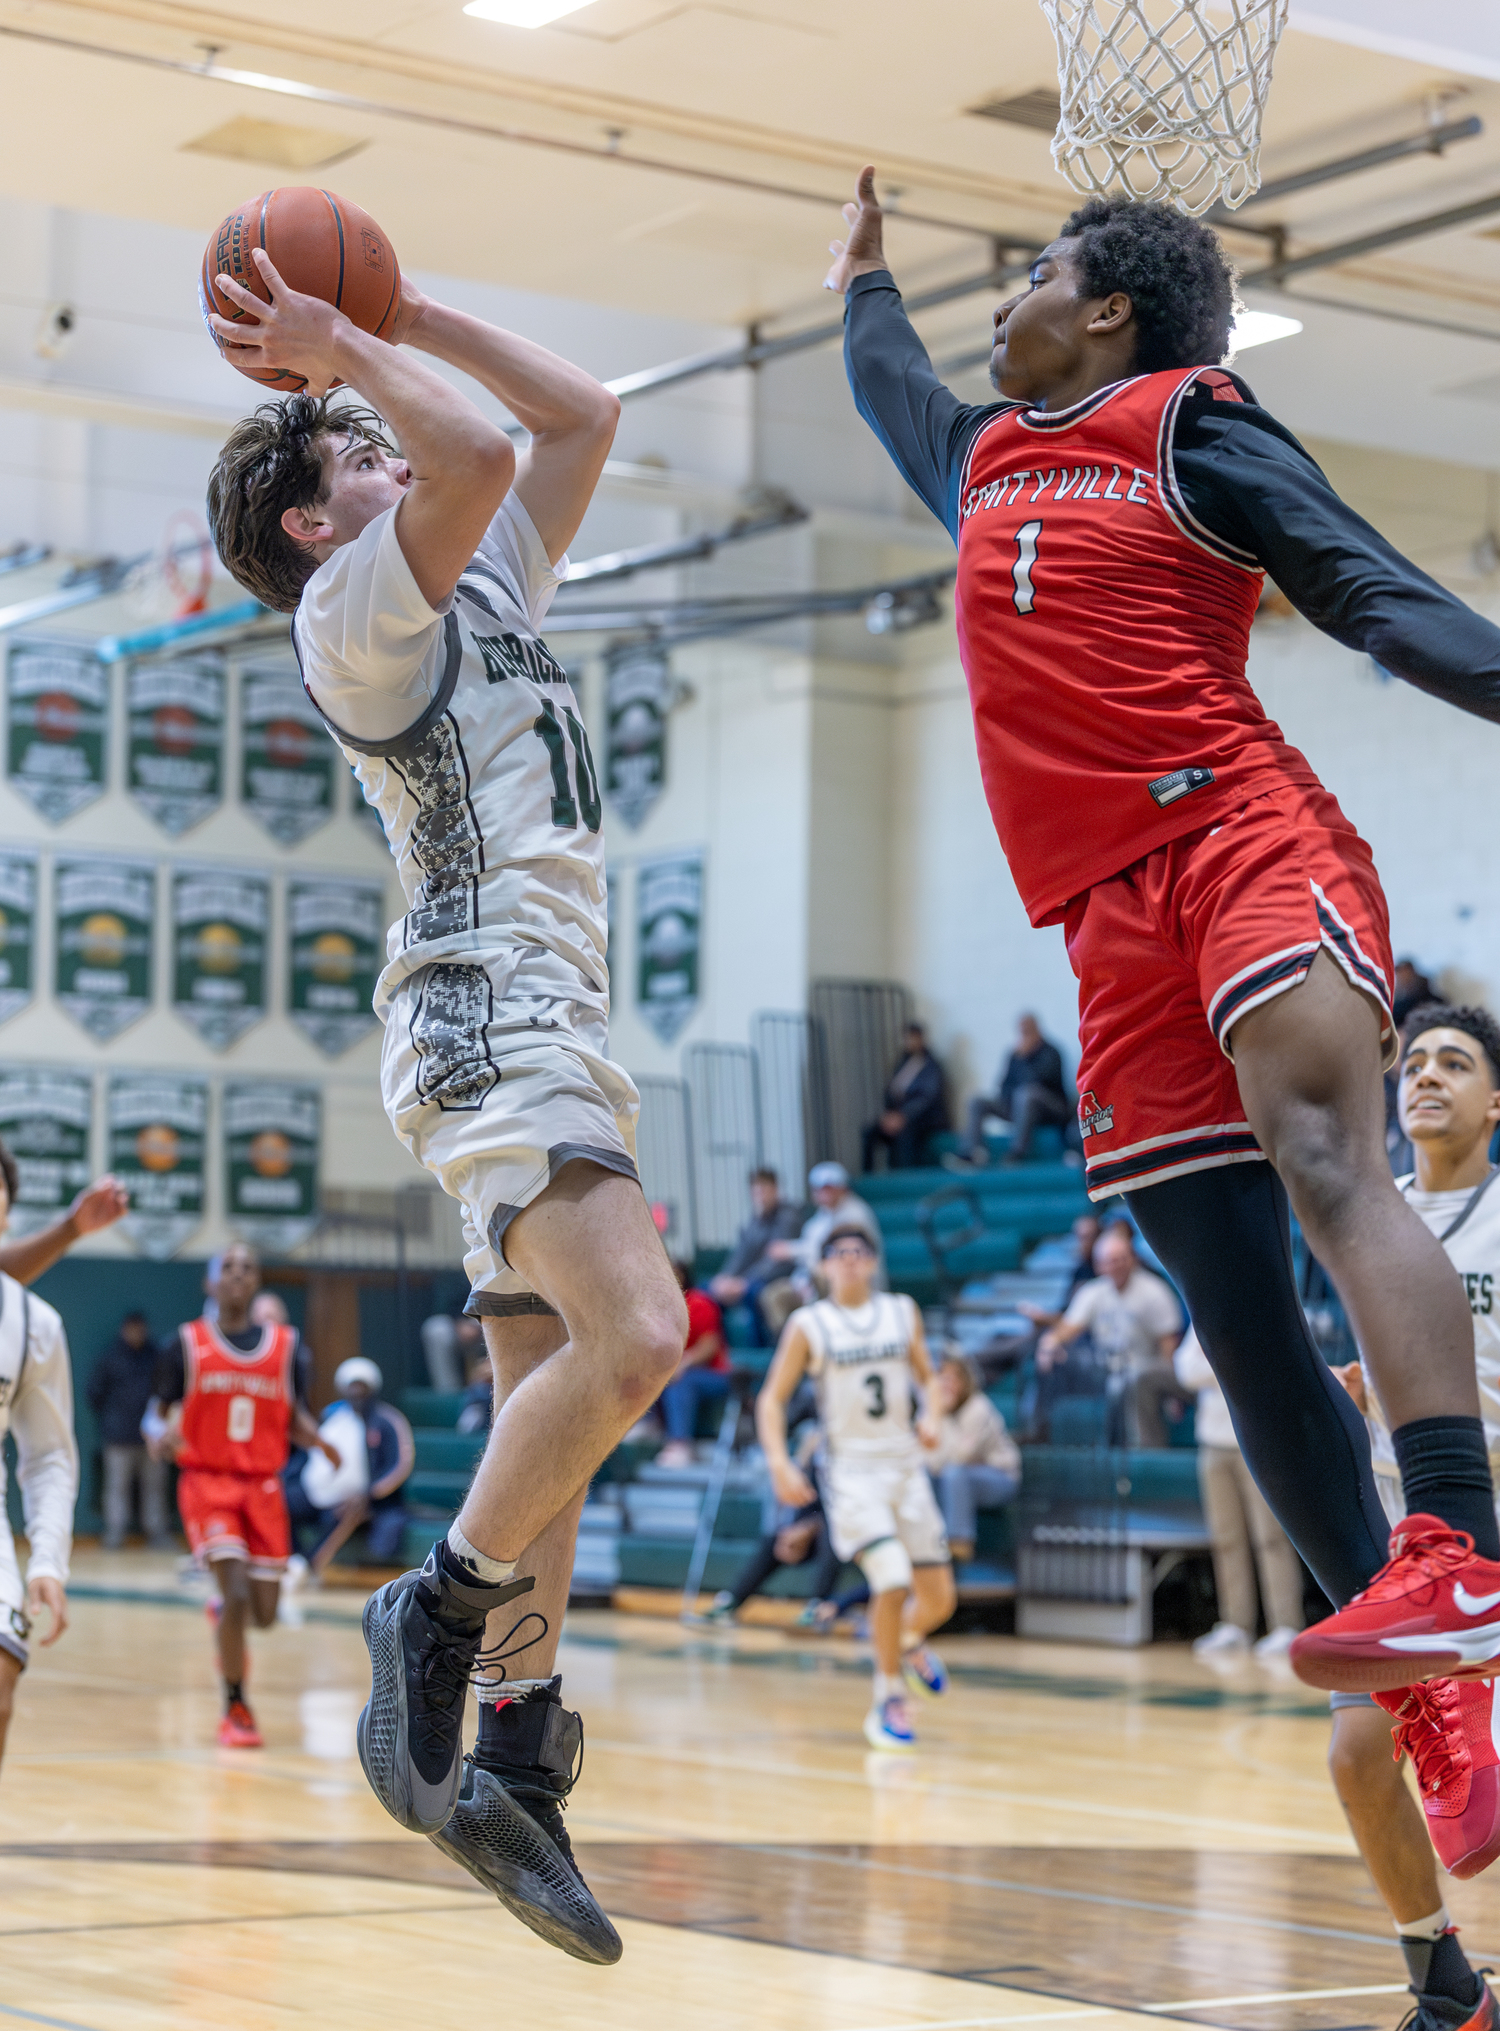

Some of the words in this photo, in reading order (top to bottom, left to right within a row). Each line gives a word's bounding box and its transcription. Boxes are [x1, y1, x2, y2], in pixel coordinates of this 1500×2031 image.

[216, 215, 246, 320] LGACY
[231, 214, 245, 276] 1000
[243, 253, 254, 278] OFFICIAL
[962, 464, 1155, 521] AMITYVILLE
[1012, 519, 1043, 615] 1
[533, 698, 602, 834] 10
[1193, 770, 1203, 780] S
[228, 1396, 255, 1442] 0
[864, 1374, 886, 1418] 3
